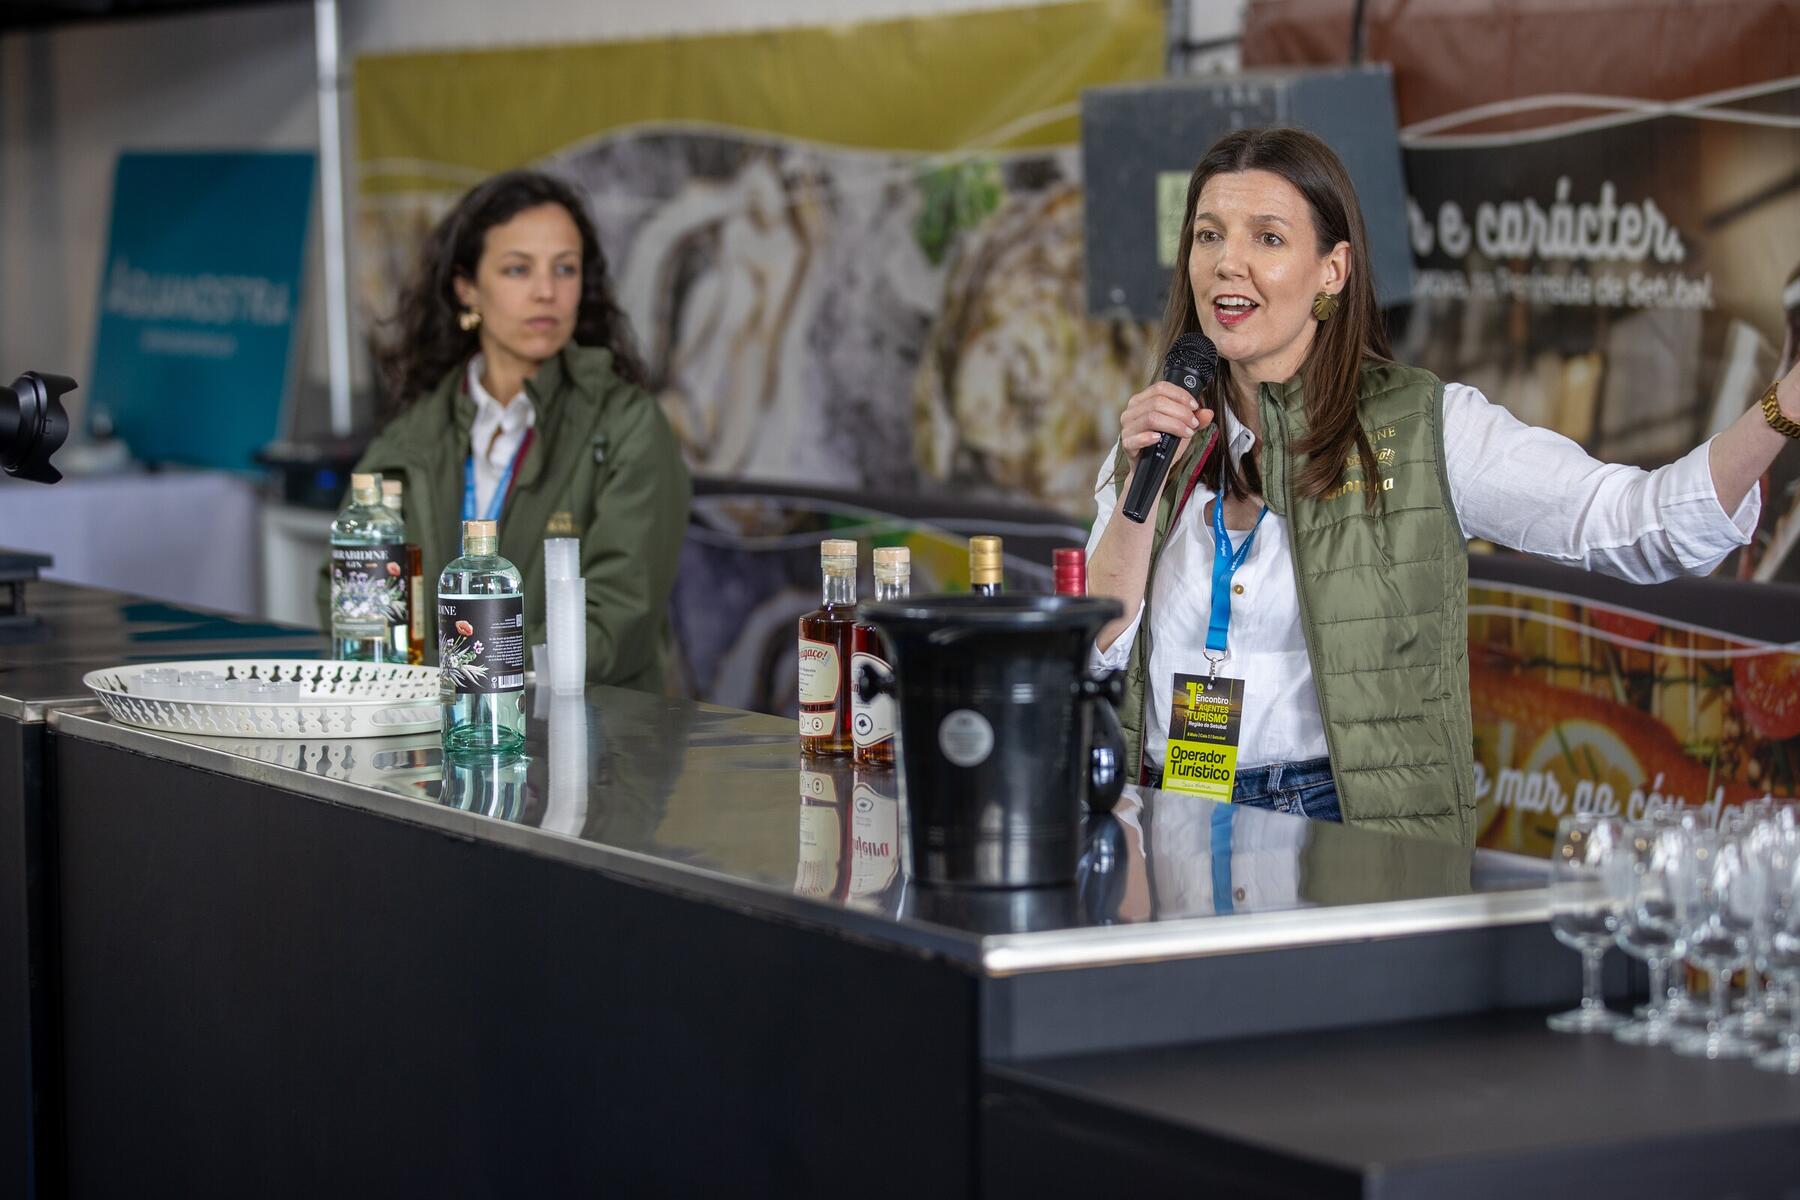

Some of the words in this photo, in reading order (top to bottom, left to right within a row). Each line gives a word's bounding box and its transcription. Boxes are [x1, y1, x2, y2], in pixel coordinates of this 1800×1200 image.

[1437, 199, 1472, 258] e
[1196, 694, 1229, 705] Encontro
[1199, 703, 1230, 714] AGENTES
[1189, 710, 1228, 724] TURISMO
[1171, 745, 1227, 764] Operador
[1170, 760, 1230, 781] Turístico
[1493, 766, 1568, 816] mar
[1573, 777, 1620, 816] ao
